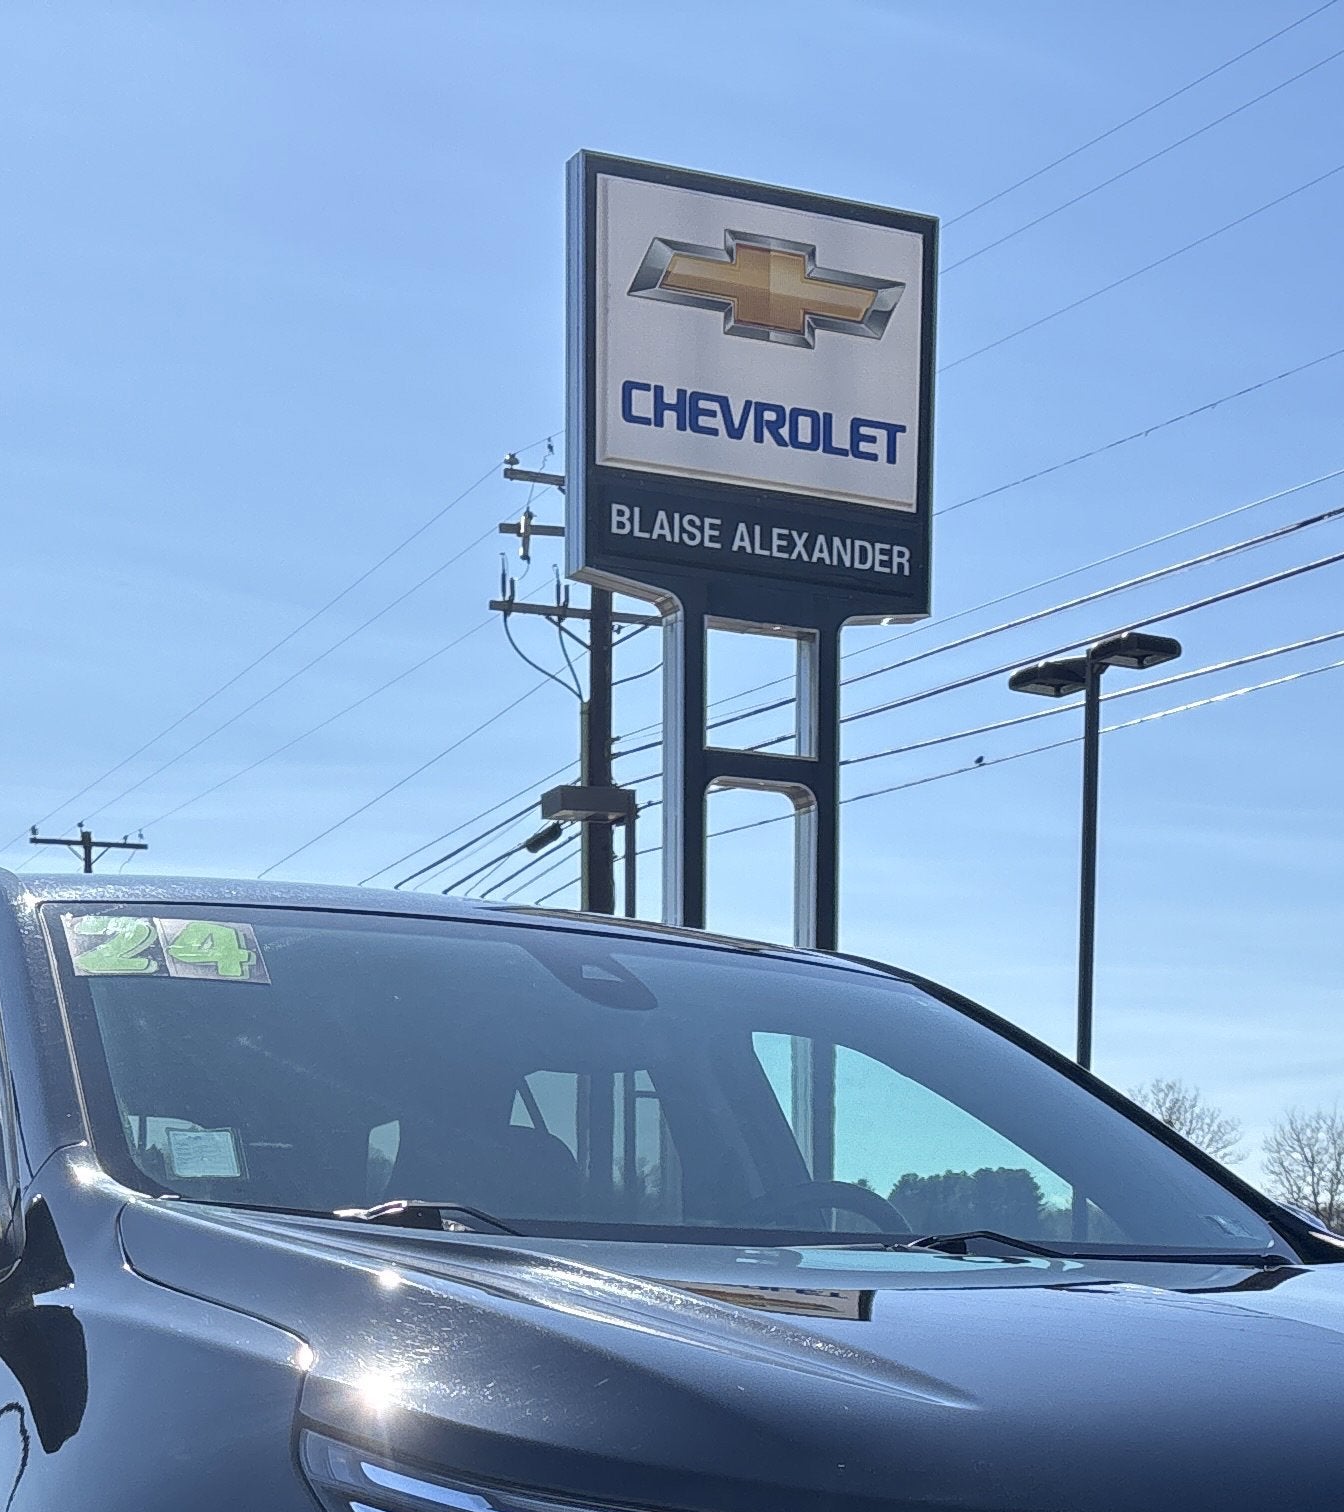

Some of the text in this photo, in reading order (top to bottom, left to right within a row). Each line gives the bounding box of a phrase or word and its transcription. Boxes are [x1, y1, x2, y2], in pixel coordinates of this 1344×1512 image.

[621, 380, 907, 465] CHEVROLET
[611, 502, 911, 577] BLAISE ALEXANDER
